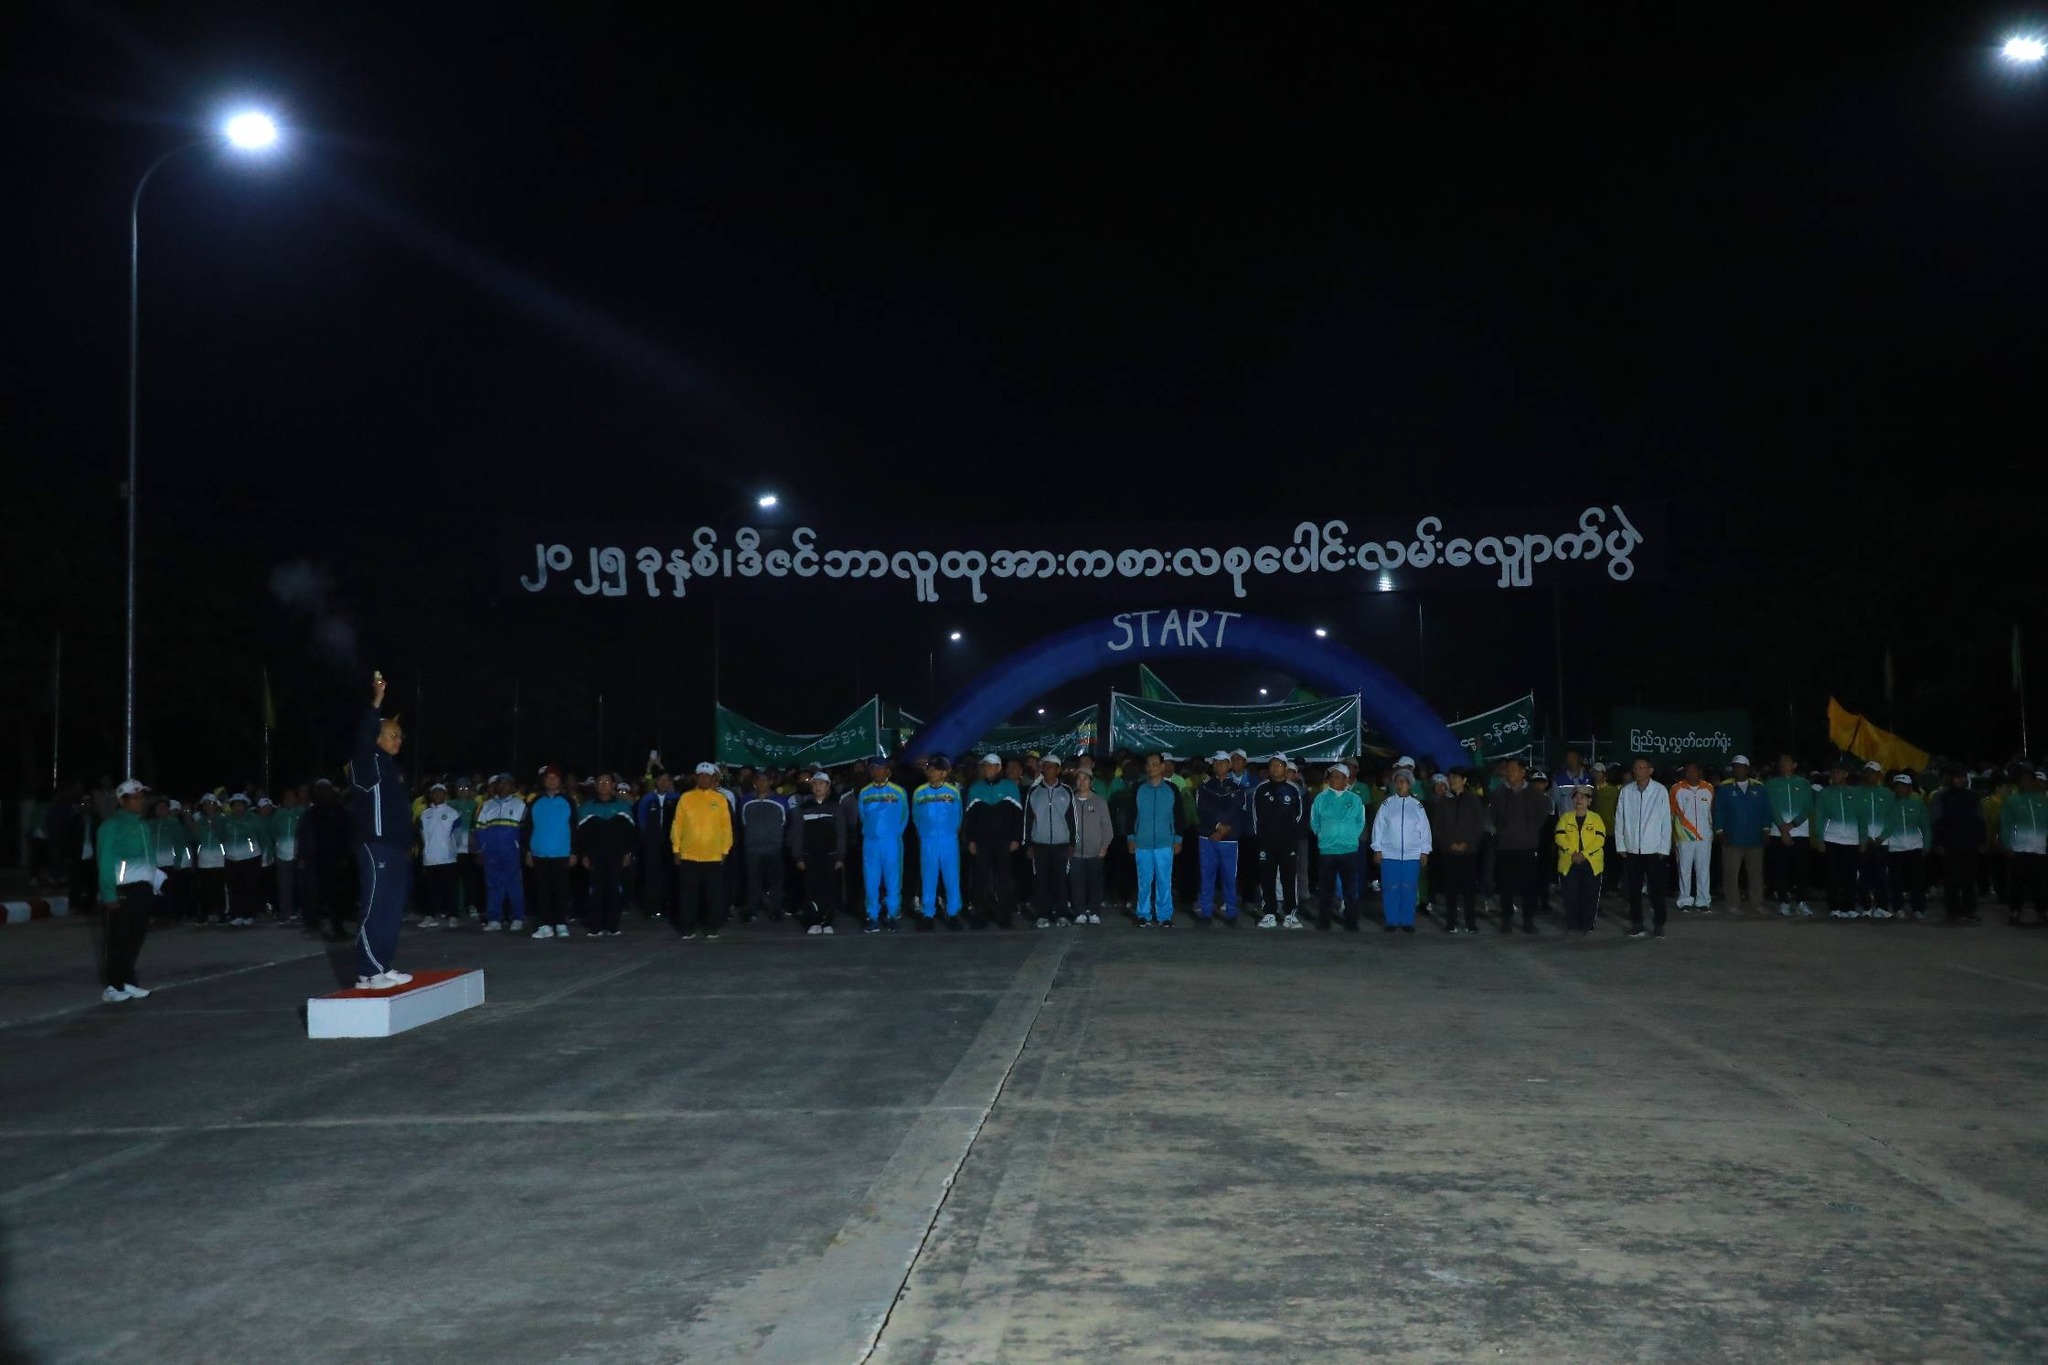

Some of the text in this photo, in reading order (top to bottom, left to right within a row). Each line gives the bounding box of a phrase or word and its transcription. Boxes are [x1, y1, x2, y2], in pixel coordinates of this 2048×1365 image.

[1107, 609, 1242, 651] START
[1630, 729, 1732, 754] ပြည်သူ့လွှတ်တော်ရုံး
